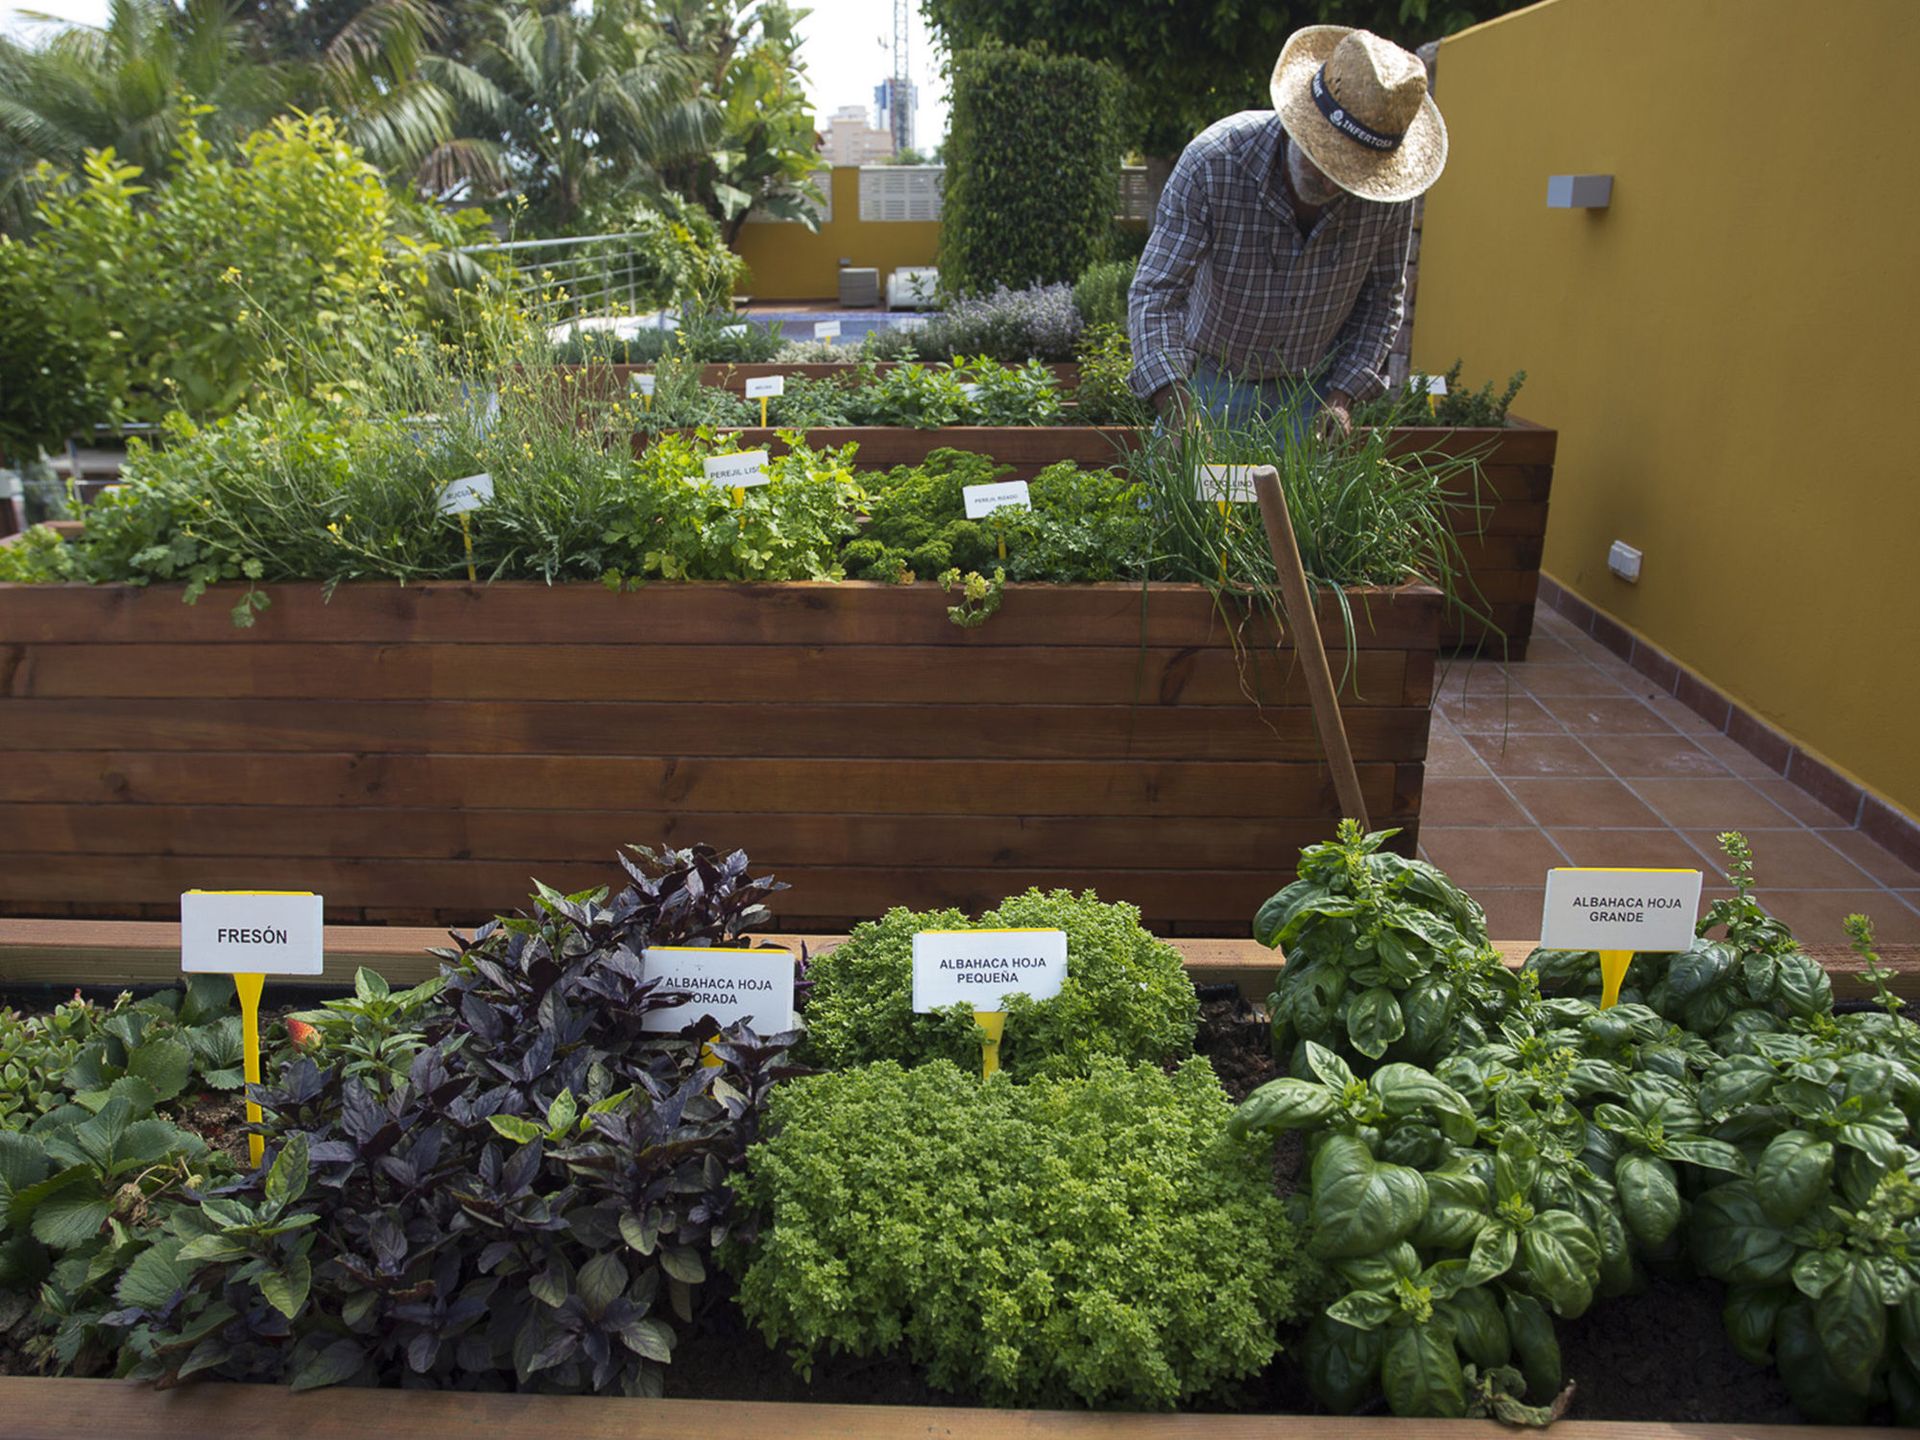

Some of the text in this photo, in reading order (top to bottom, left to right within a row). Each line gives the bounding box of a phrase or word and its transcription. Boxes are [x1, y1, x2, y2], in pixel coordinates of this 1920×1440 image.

[710, 469, 742, 479] PEREJIL
[1572, 896, 1682, 909] ALBAHACA HOJA
[1589, 911, 1644, 923] GRANDE
[217, 925, 287, 944] FRESÓN
[939, 957, 1047, 969] ALBAHACA HOJA
[957, 970, 1019, 984] PEQUEÑA
[665, 977, 773, 991] ALBAHACA HOJA
[687, 992, 738, 1005] ORADA
